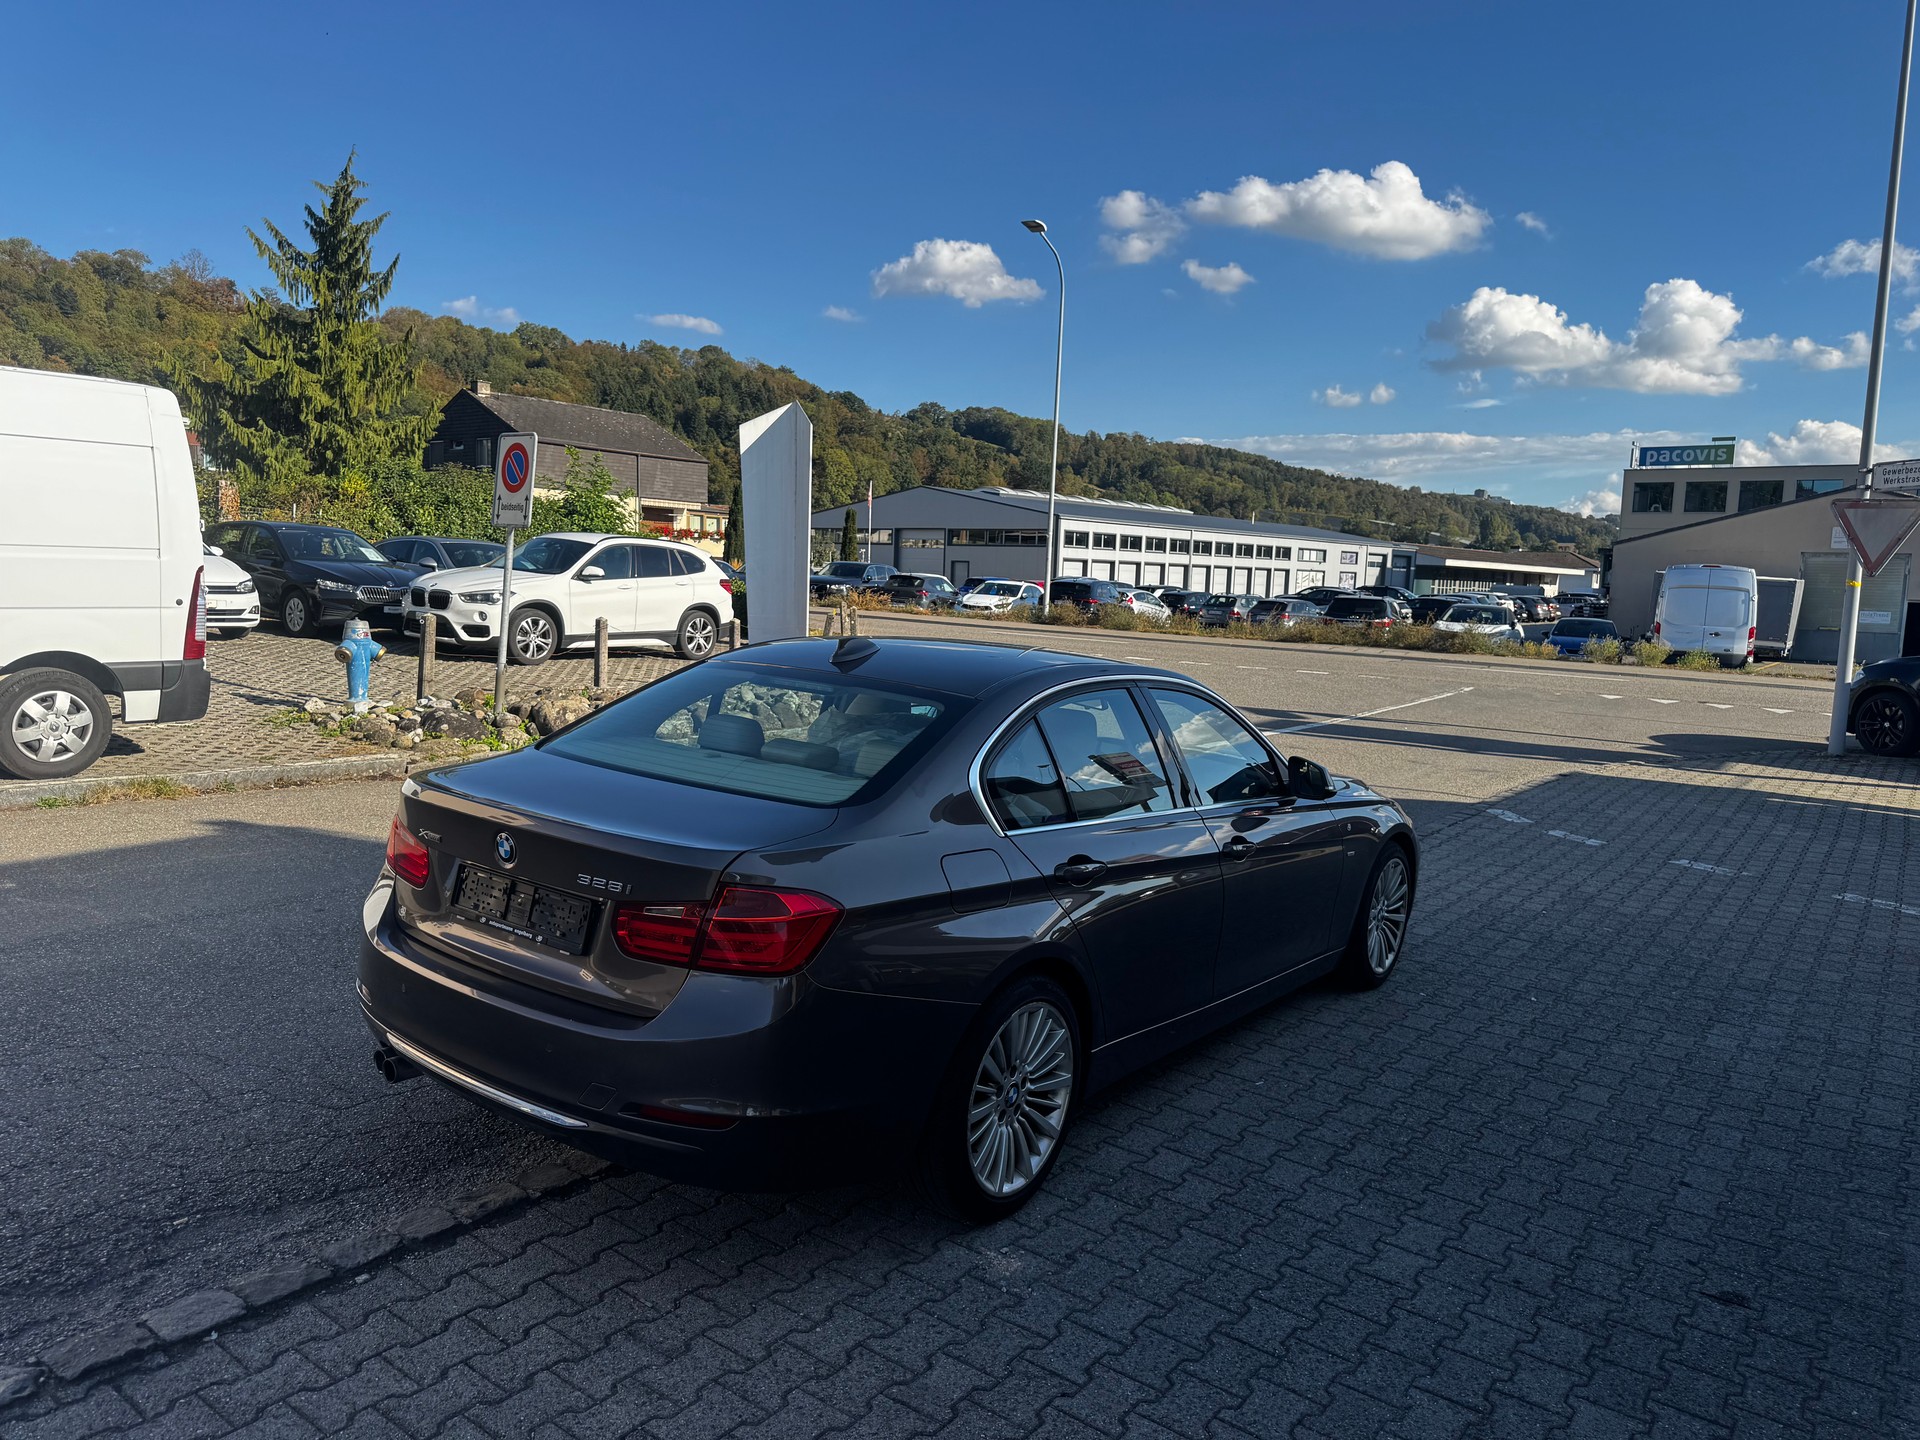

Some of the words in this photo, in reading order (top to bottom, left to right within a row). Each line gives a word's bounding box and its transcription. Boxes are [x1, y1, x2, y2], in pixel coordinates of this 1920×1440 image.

[1645, 448, 1727, 466] pacovis
[1883, 476, 1920, 485] Werkstras
[501, 503, 524, 513] beidseitig
